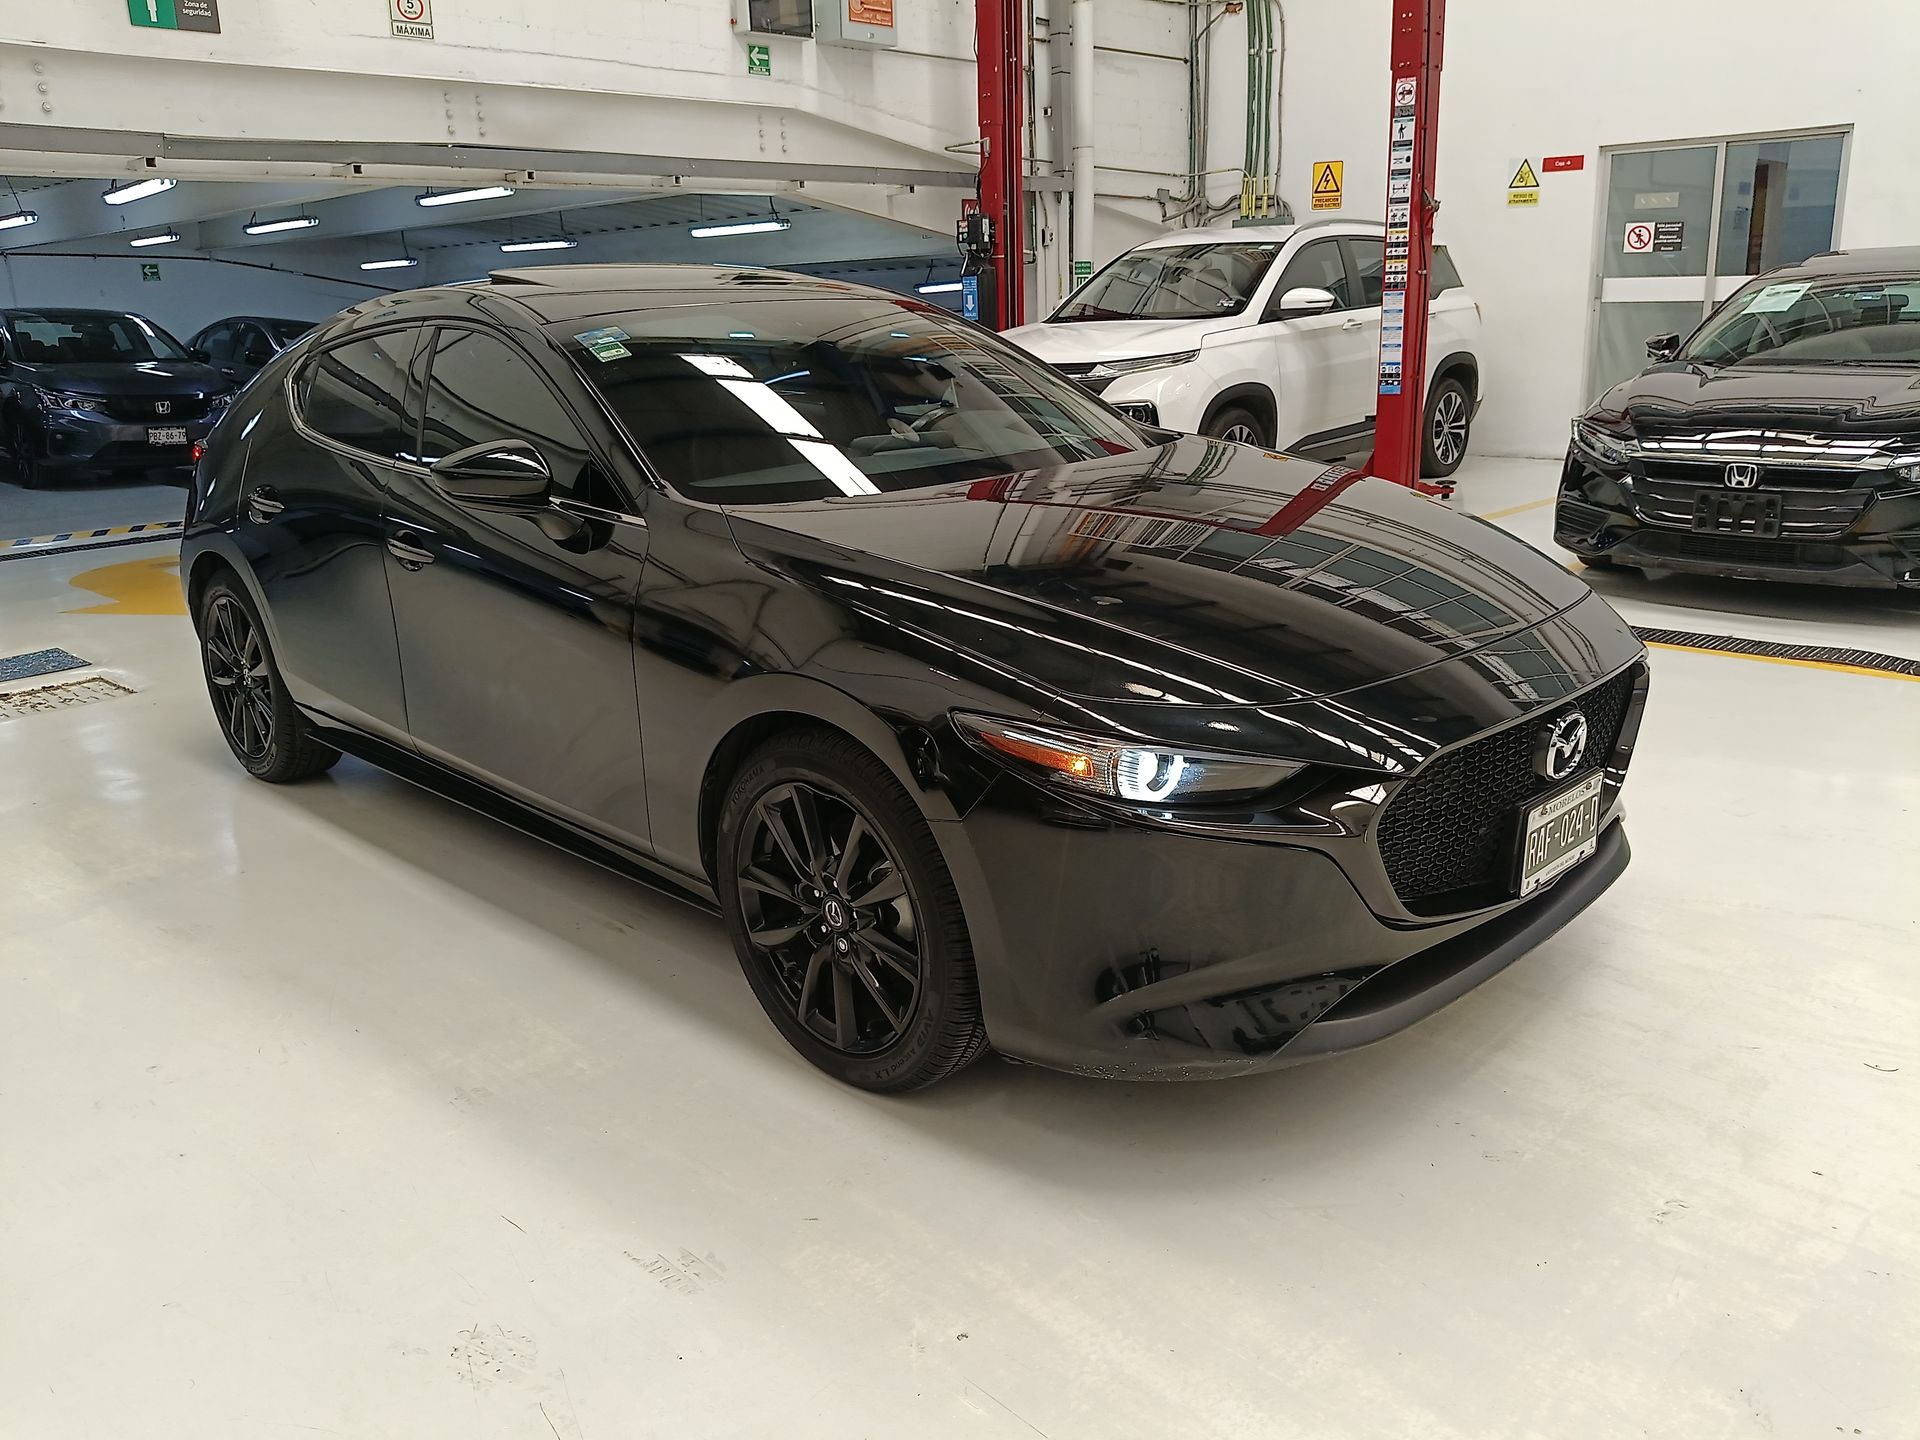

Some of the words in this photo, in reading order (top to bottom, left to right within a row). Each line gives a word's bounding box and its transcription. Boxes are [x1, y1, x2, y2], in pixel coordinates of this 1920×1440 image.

[184, 0, 199, 8] Zona
[406, 0, 414, 9] 5
[182, 8, 212, 17] seguridad
[396, 24, 431, 38] MÁXIMA
[150, 431, 186, 441] PBZ-86-79
[731, 765, 766, 805] YOKOHAMA
[1548, 789, 1585, 816] MORELOS
[1527, 795, 1599, 870] RAF-024-D
[916, 1007, 934, 1048] AVID
[874, 1067, 891, 1080] LX
